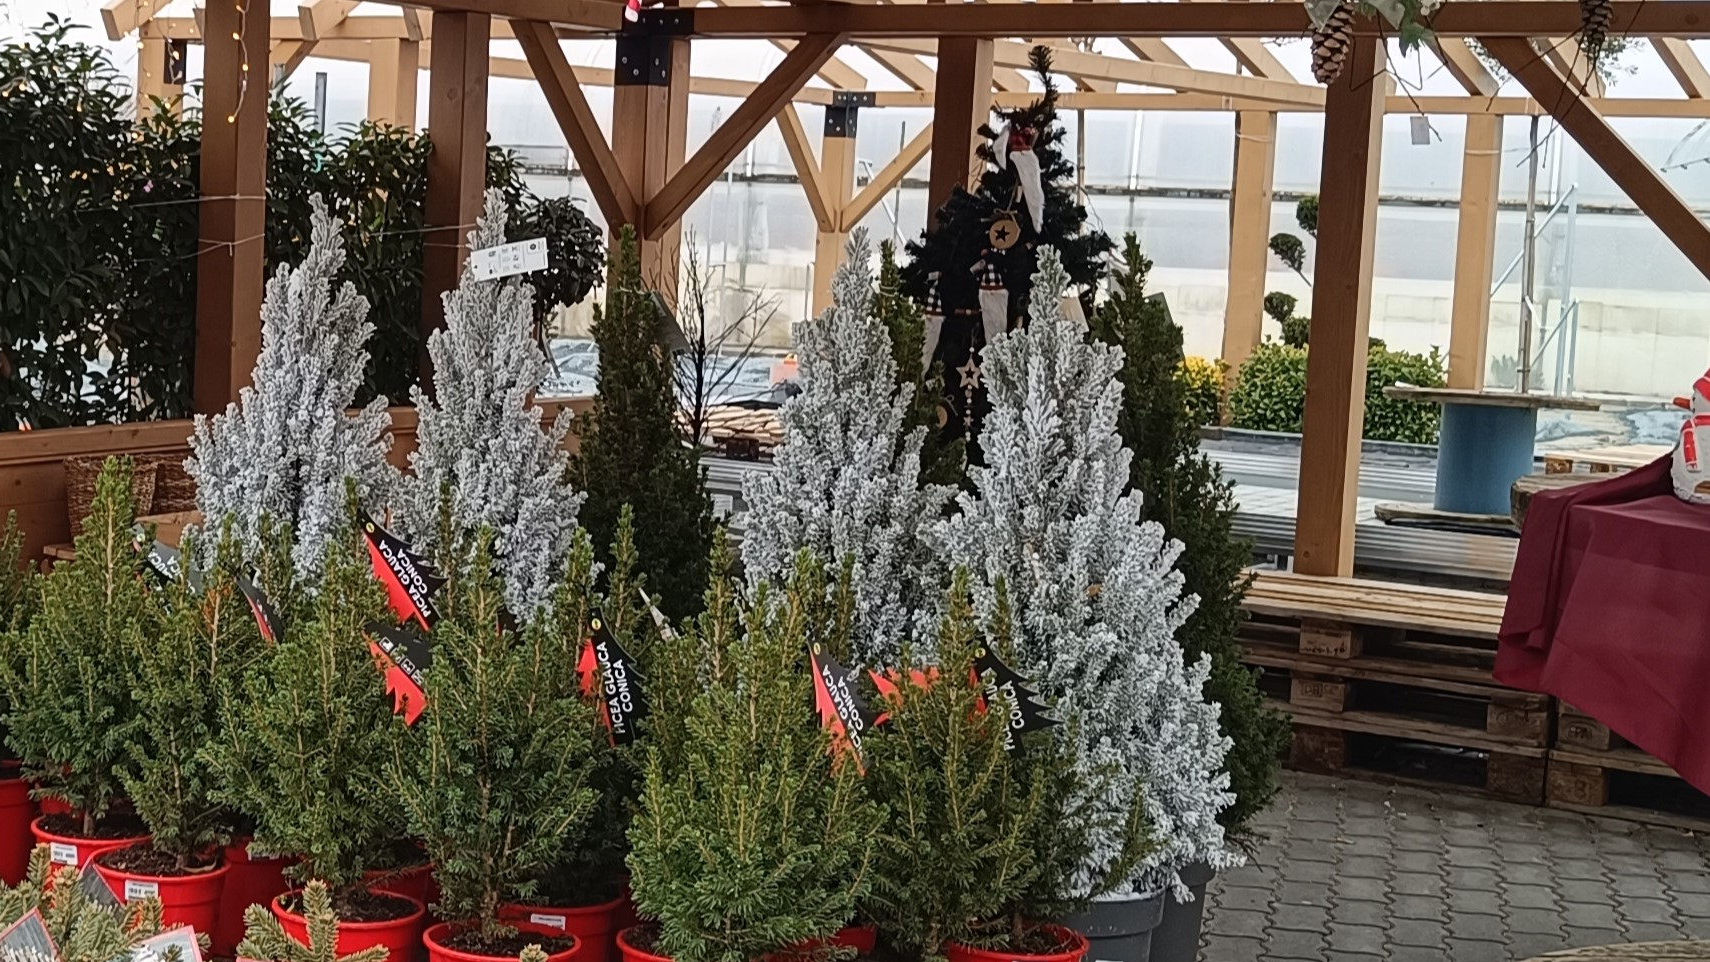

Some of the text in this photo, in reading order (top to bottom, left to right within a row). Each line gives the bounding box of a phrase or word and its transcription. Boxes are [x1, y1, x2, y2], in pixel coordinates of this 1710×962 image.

[379, 539, 432, 618] PICEA GLAUCA
[397, 548, 428, 594] CONICA
[613, 659, 634, 713] CONICA
[822, 664, 849, 720] GLAUCA
[838, 675, 864, 731] CONICA
